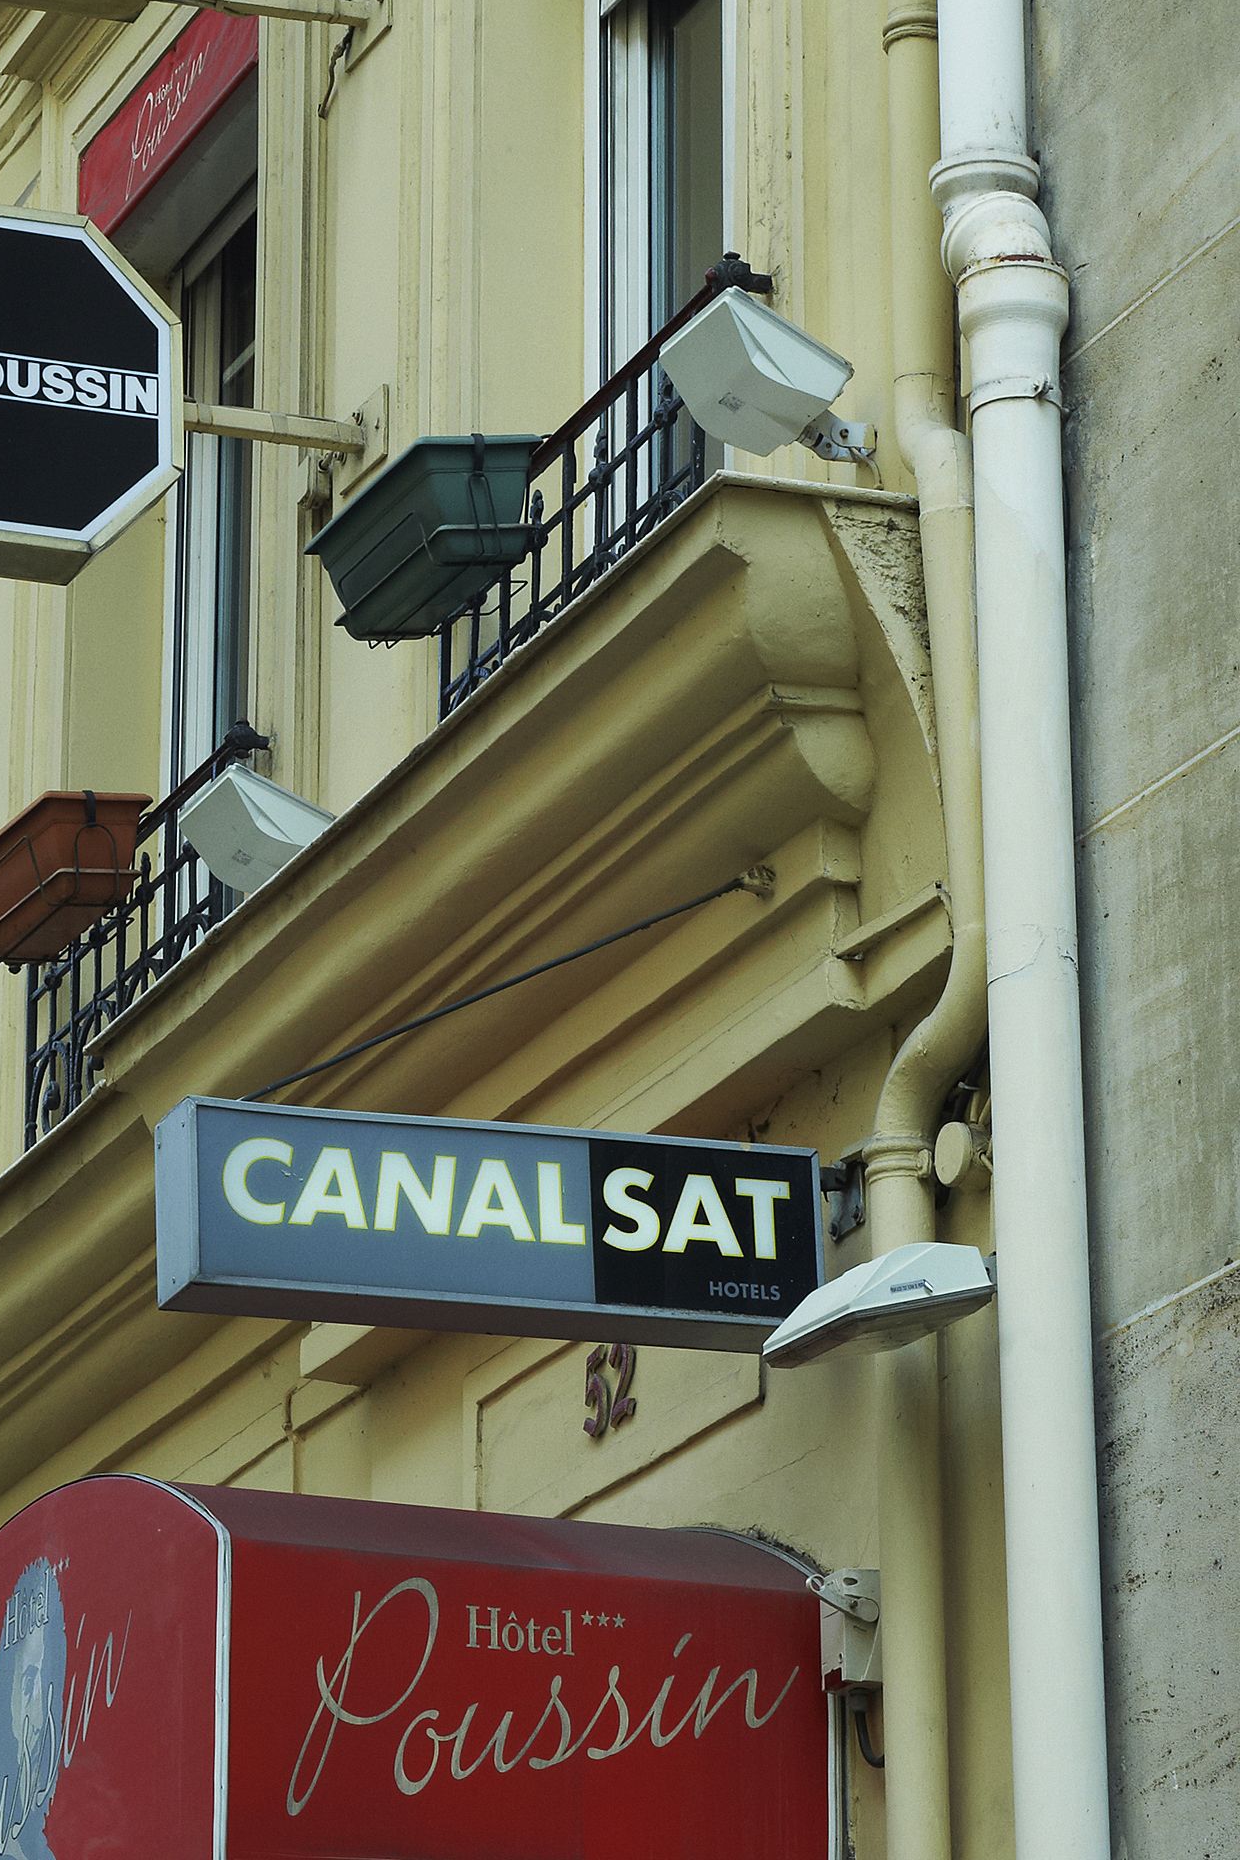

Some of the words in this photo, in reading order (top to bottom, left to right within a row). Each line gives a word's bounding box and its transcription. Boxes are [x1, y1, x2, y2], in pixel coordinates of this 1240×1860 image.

[125, 41, 210, 201] Poussin
[709, 1281, 781, 1301] HOTELS
[3, 1567, 50, 1652] Hôtel
[465, 1604, 575, 1657] Hôtel
[286, 1576, 800, 1817] Poussin
